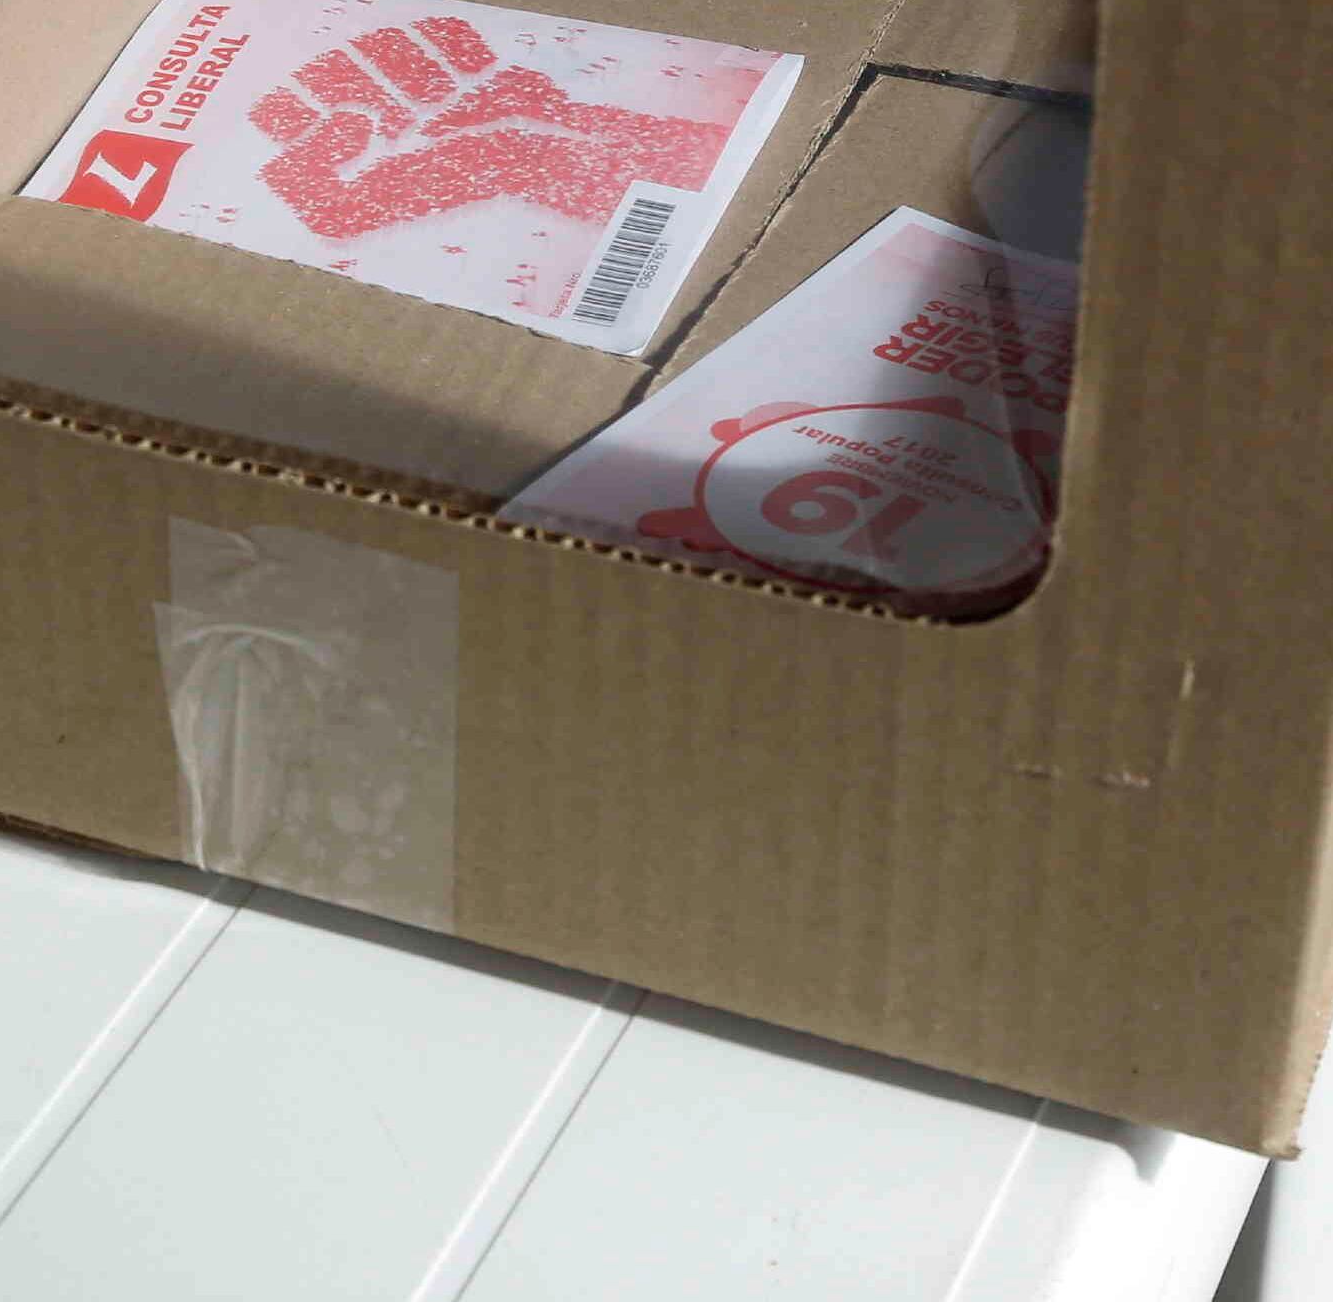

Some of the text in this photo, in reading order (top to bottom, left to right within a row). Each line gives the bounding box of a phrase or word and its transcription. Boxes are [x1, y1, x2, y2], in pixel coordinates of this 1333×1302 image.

[124, 5, 232, 124] CONSULTA
[160, 34, 251, 131] LIBERAL
[83, 151, 158, 209] L
[873, 335, 1069, 414] PODER
[793, 425, 896, 465] Popular
[883, 435, 956, 465] 2017
[762, 471, 929, 564] 19
